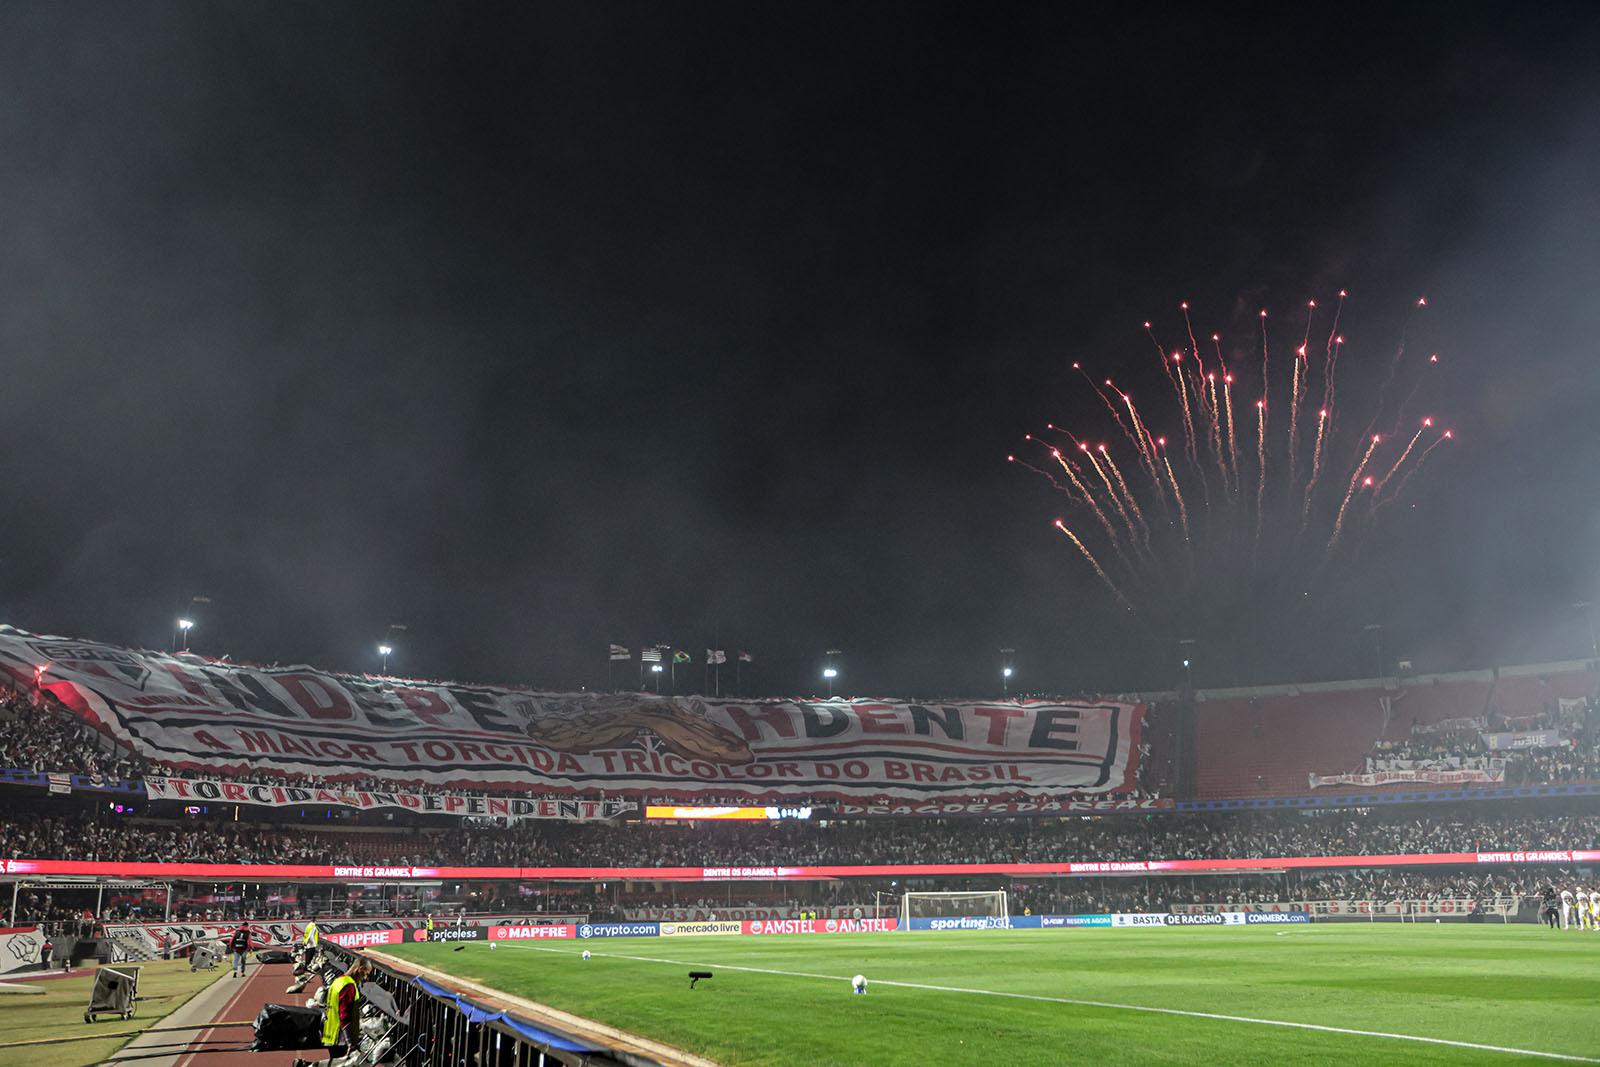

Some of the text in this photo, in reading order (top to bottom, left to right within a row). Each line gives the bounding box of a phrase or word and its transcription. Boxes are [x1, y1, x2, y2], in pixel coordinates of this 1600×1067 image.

[193, 729, 1032, 782] A MAIOR TORCIDA TRICOLOR DO BRASIL
[167, 779, 620, 817] TORCIDA INDEPENDENTE
[334, 867, 362, 876] DENTRE
[363, 867, 373, 876] OS
[1133, 914, 1222, 925] BASTA DE RACISMO
[509, 926, 567, 938] MAPFRE
[594, 924, 656, 937] crypto.com
[677, 923, 740, 933] mercado livre
[764, 919, 815, 933] AMSTEL
[338, 931, 389, 946] MAPFRE
[433, 928, 478, 940] priceless
